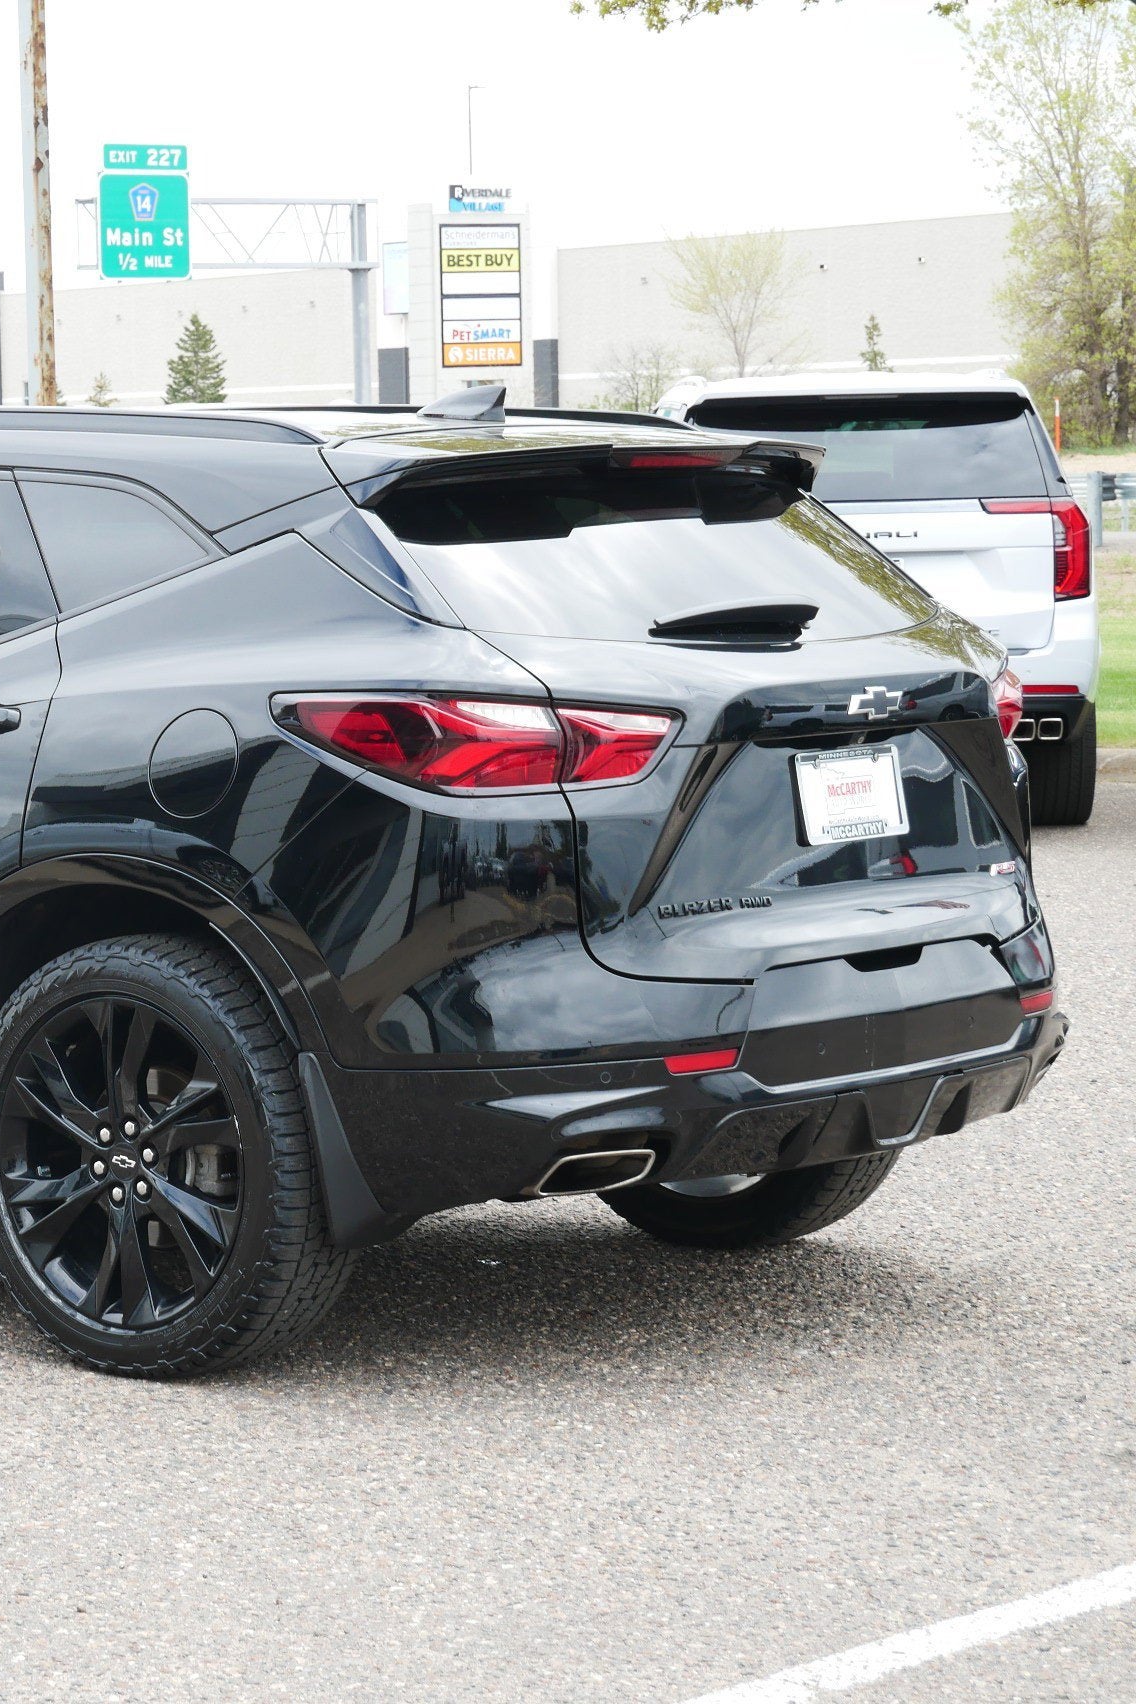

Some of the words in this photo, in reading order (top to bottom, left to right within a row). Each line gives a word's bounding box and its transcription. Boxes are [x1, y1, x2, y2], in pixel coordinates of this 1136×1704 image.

[109, 150, 137, 163] EXIT
[146, 148, 182, 166] 227
[136, 195, 151, 212] 14
[106, 227, 153, 246] Main
[162, 227, 184, 246] St
[144, 255, 173, 268] MILE
[447, 254, 481, 267] BEST
[485, 253, 513, 266] BUY
[465, 347, 516, 361] SIERRA
[818, 749, 874, 761] MINNESOTA
[827, 780, 872, 797] McCARTHY
[658, 896, 733, 919] BLAZER
[739, 896, 772, 909] AWD
